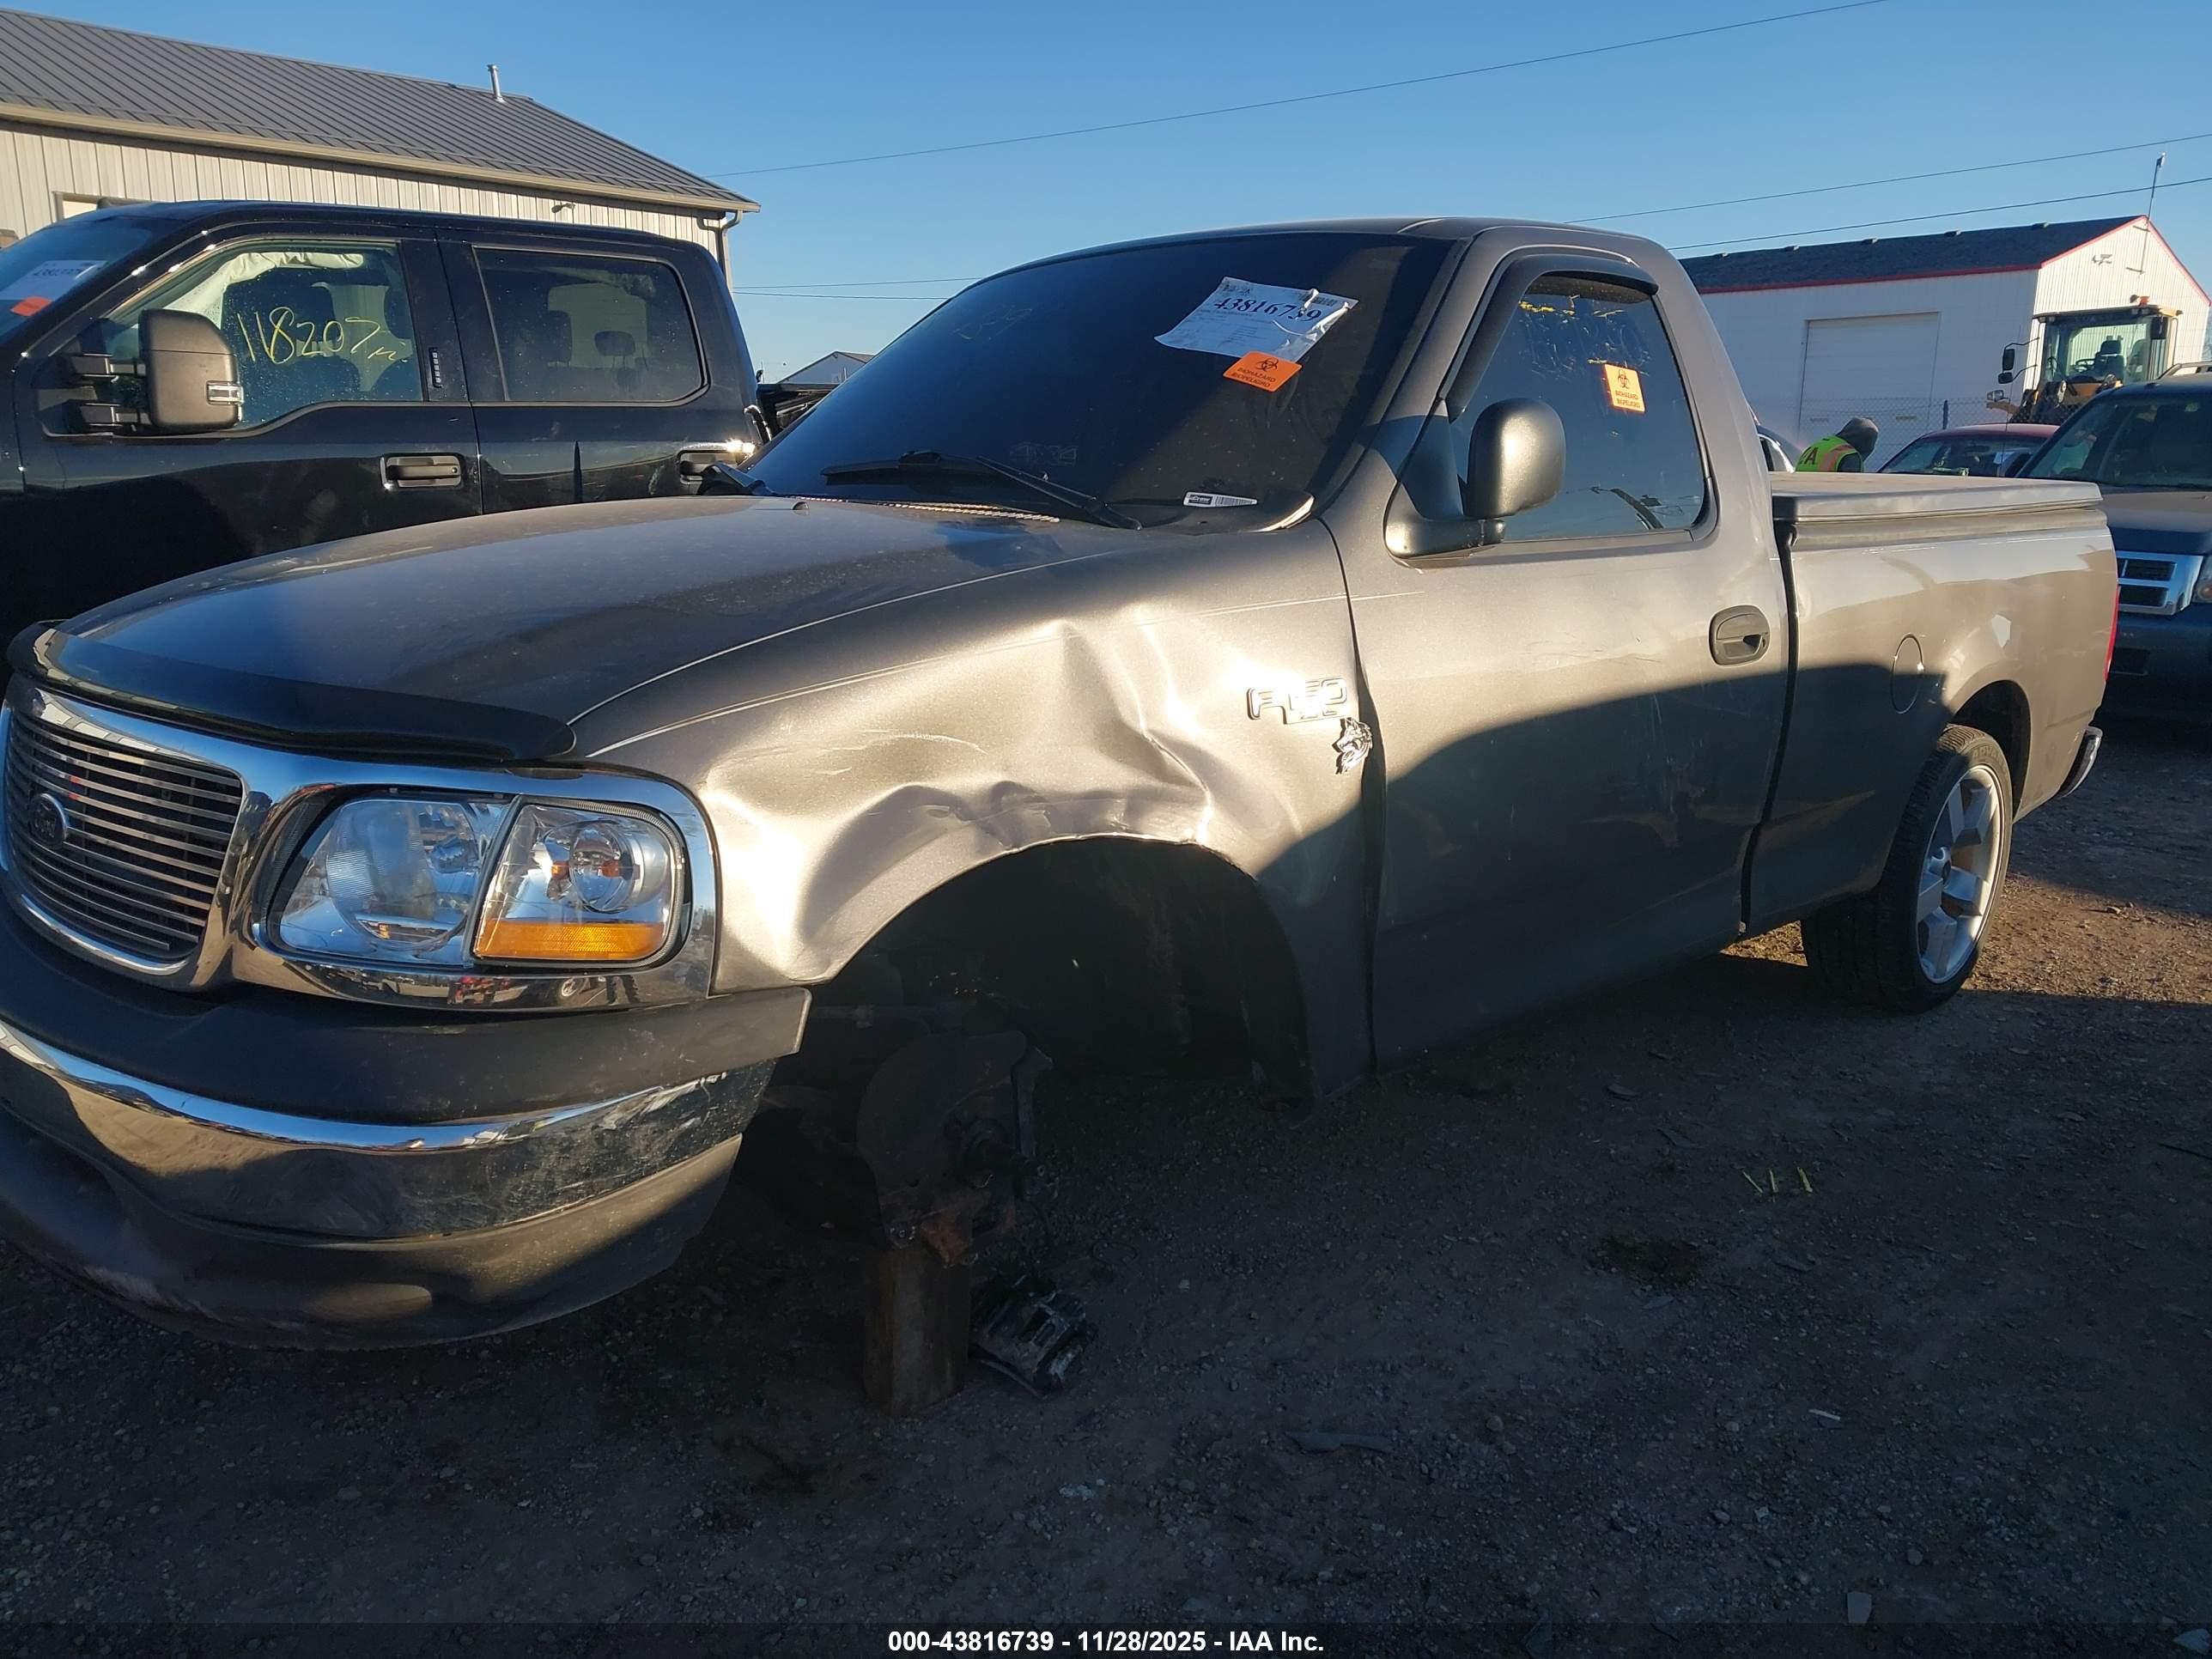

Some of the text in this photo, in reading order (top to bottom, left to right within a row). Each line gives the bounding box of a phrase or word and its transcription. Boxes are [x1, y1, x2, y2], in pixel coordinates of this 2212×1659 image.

[1214, 297, 1322, 322] 43816739
[237, 306, 380, 364] 118207
[1237, 367, 1277, 383] BIOHAZARD
[1614, 390, 1639, 400] BIOHAZARD
